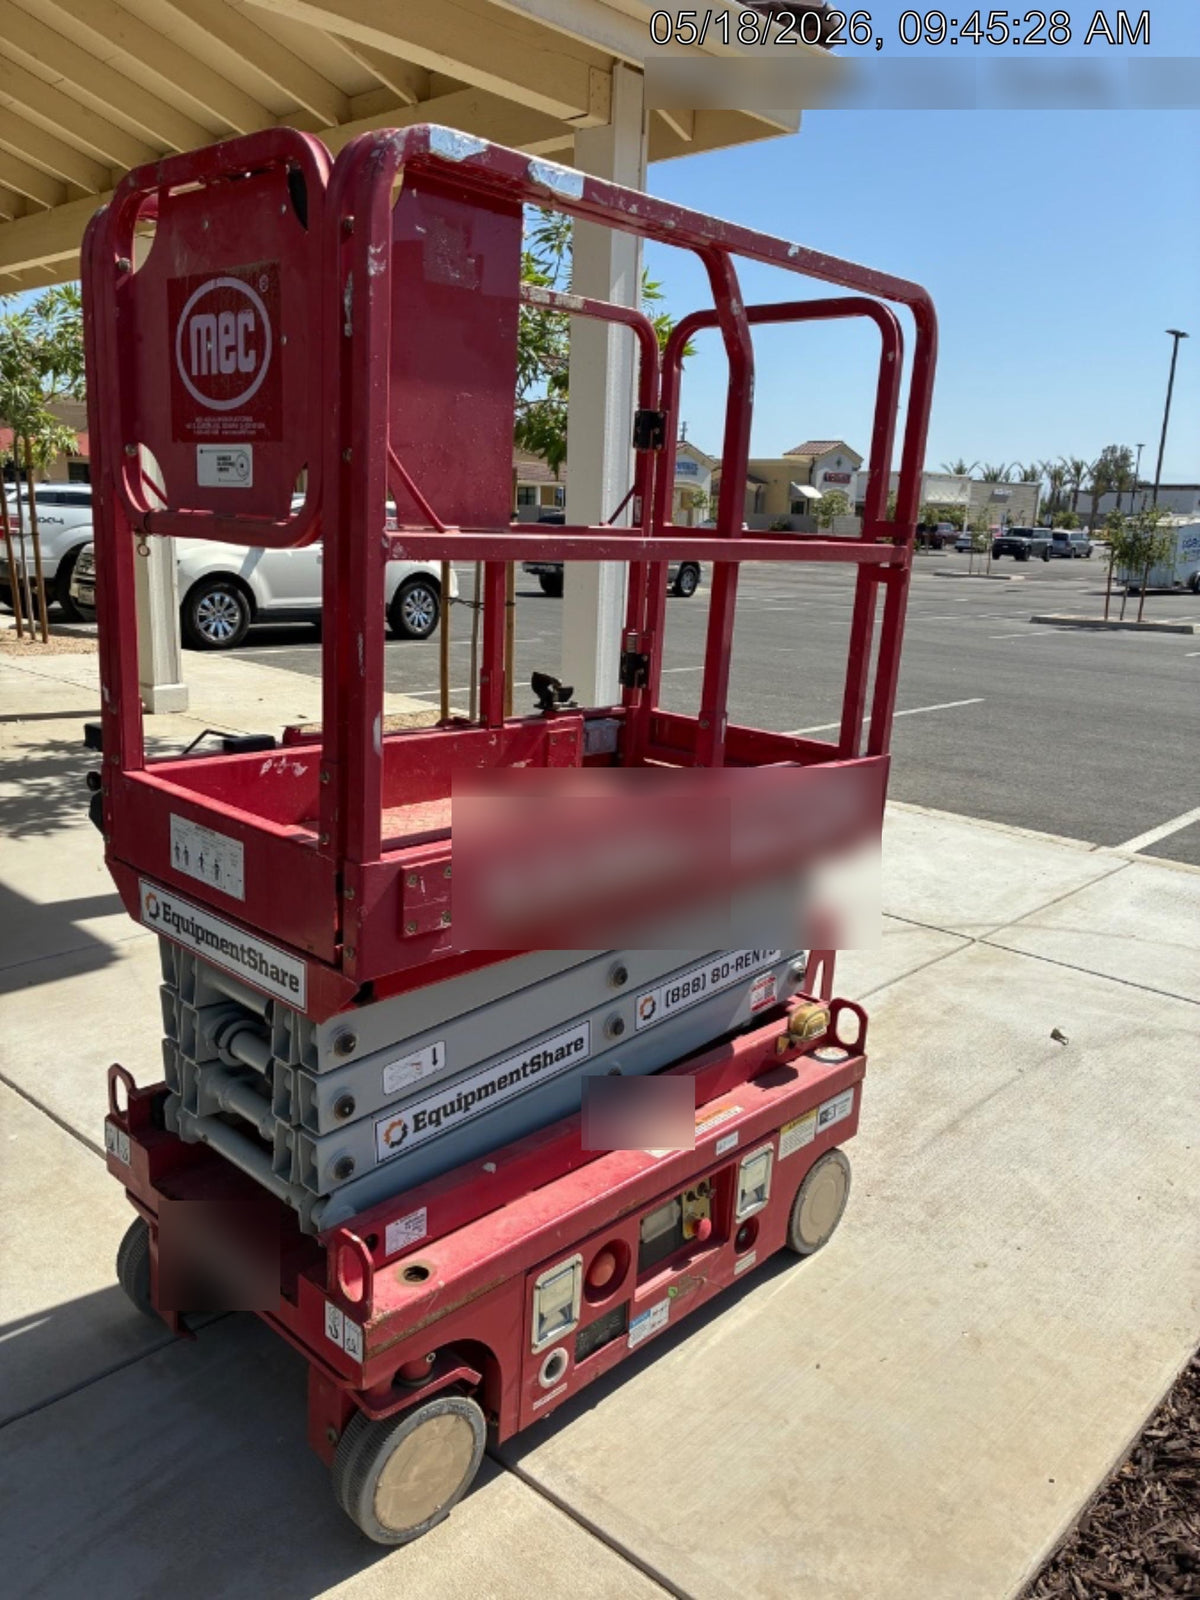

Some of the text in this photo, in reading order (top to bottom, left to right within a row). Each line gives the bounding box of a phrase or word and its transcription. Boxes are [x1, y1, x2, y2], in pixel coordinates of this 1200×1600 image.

[161, 901, 300, 993] EquipmentShare
[665, 973, 707, 1009] (888)
[412, 1036, 585, 1134] EquipmentShare
